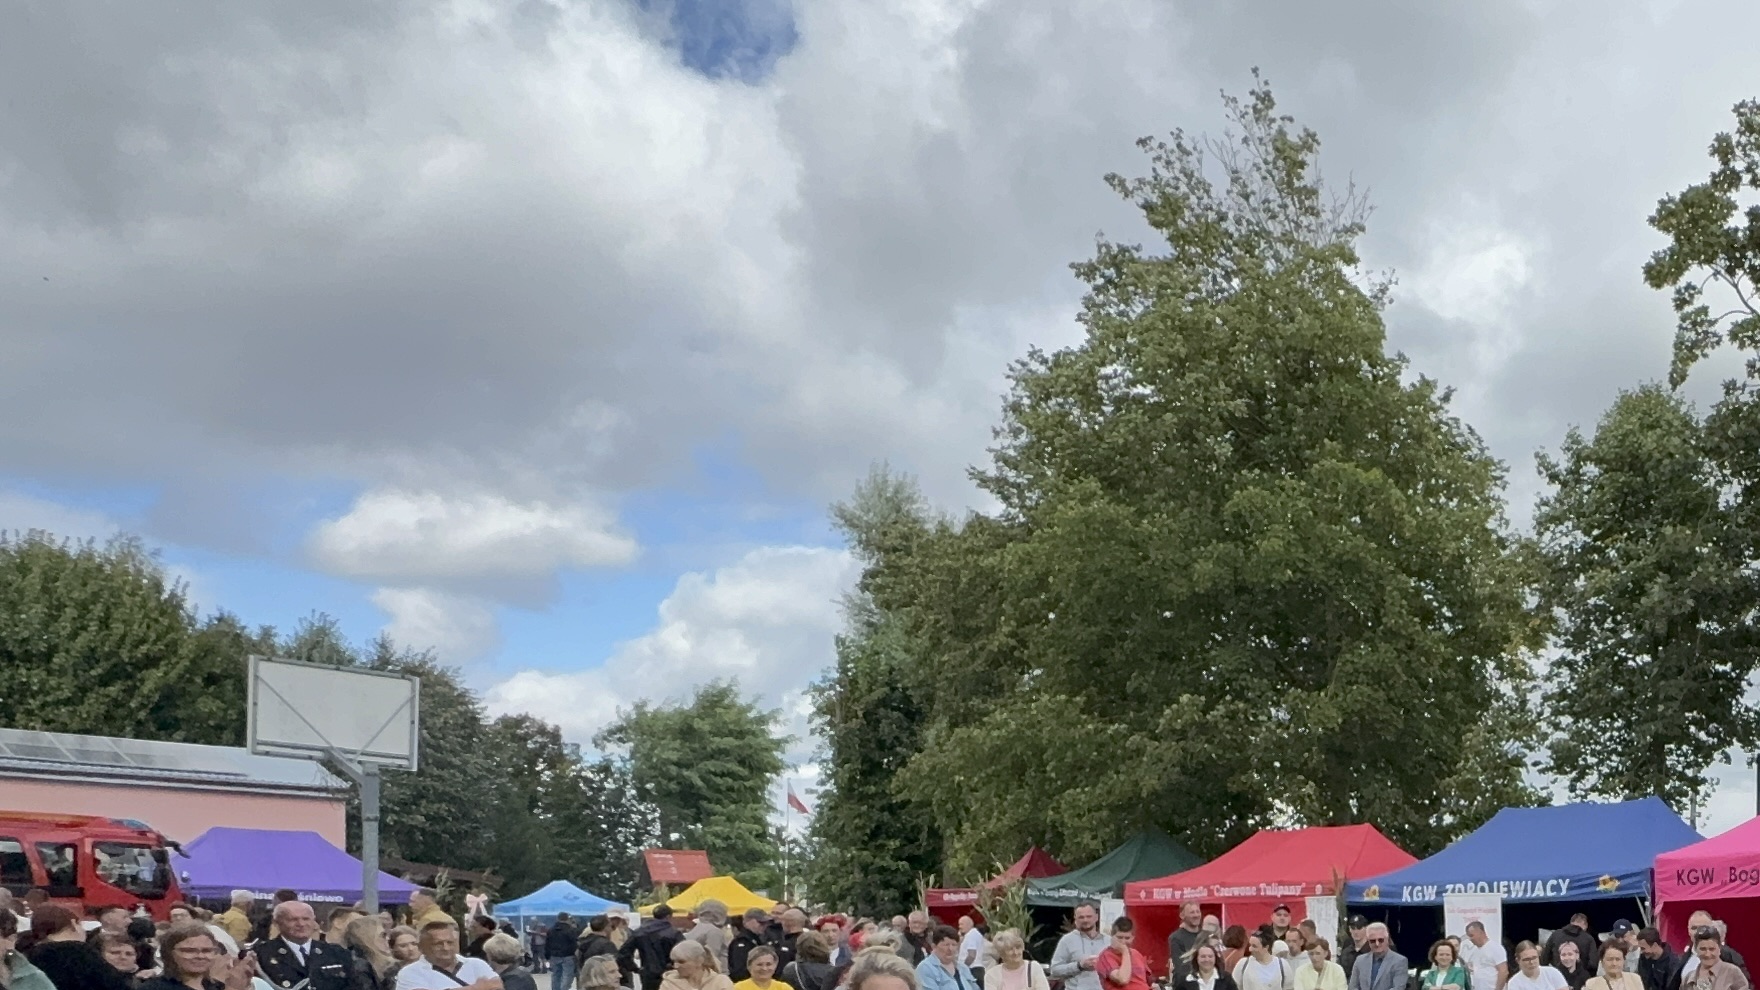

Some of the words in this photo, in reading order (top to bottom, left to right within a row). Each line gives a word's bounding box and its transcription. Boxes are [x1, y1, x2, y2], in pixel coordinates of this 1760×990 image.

[1677, 867, 1714, 886] KGW
[1153, 888, 1172, 899] KGW
[1174, 890, 1181, 899] w
[1401, 885, 1437, 902] KGW
